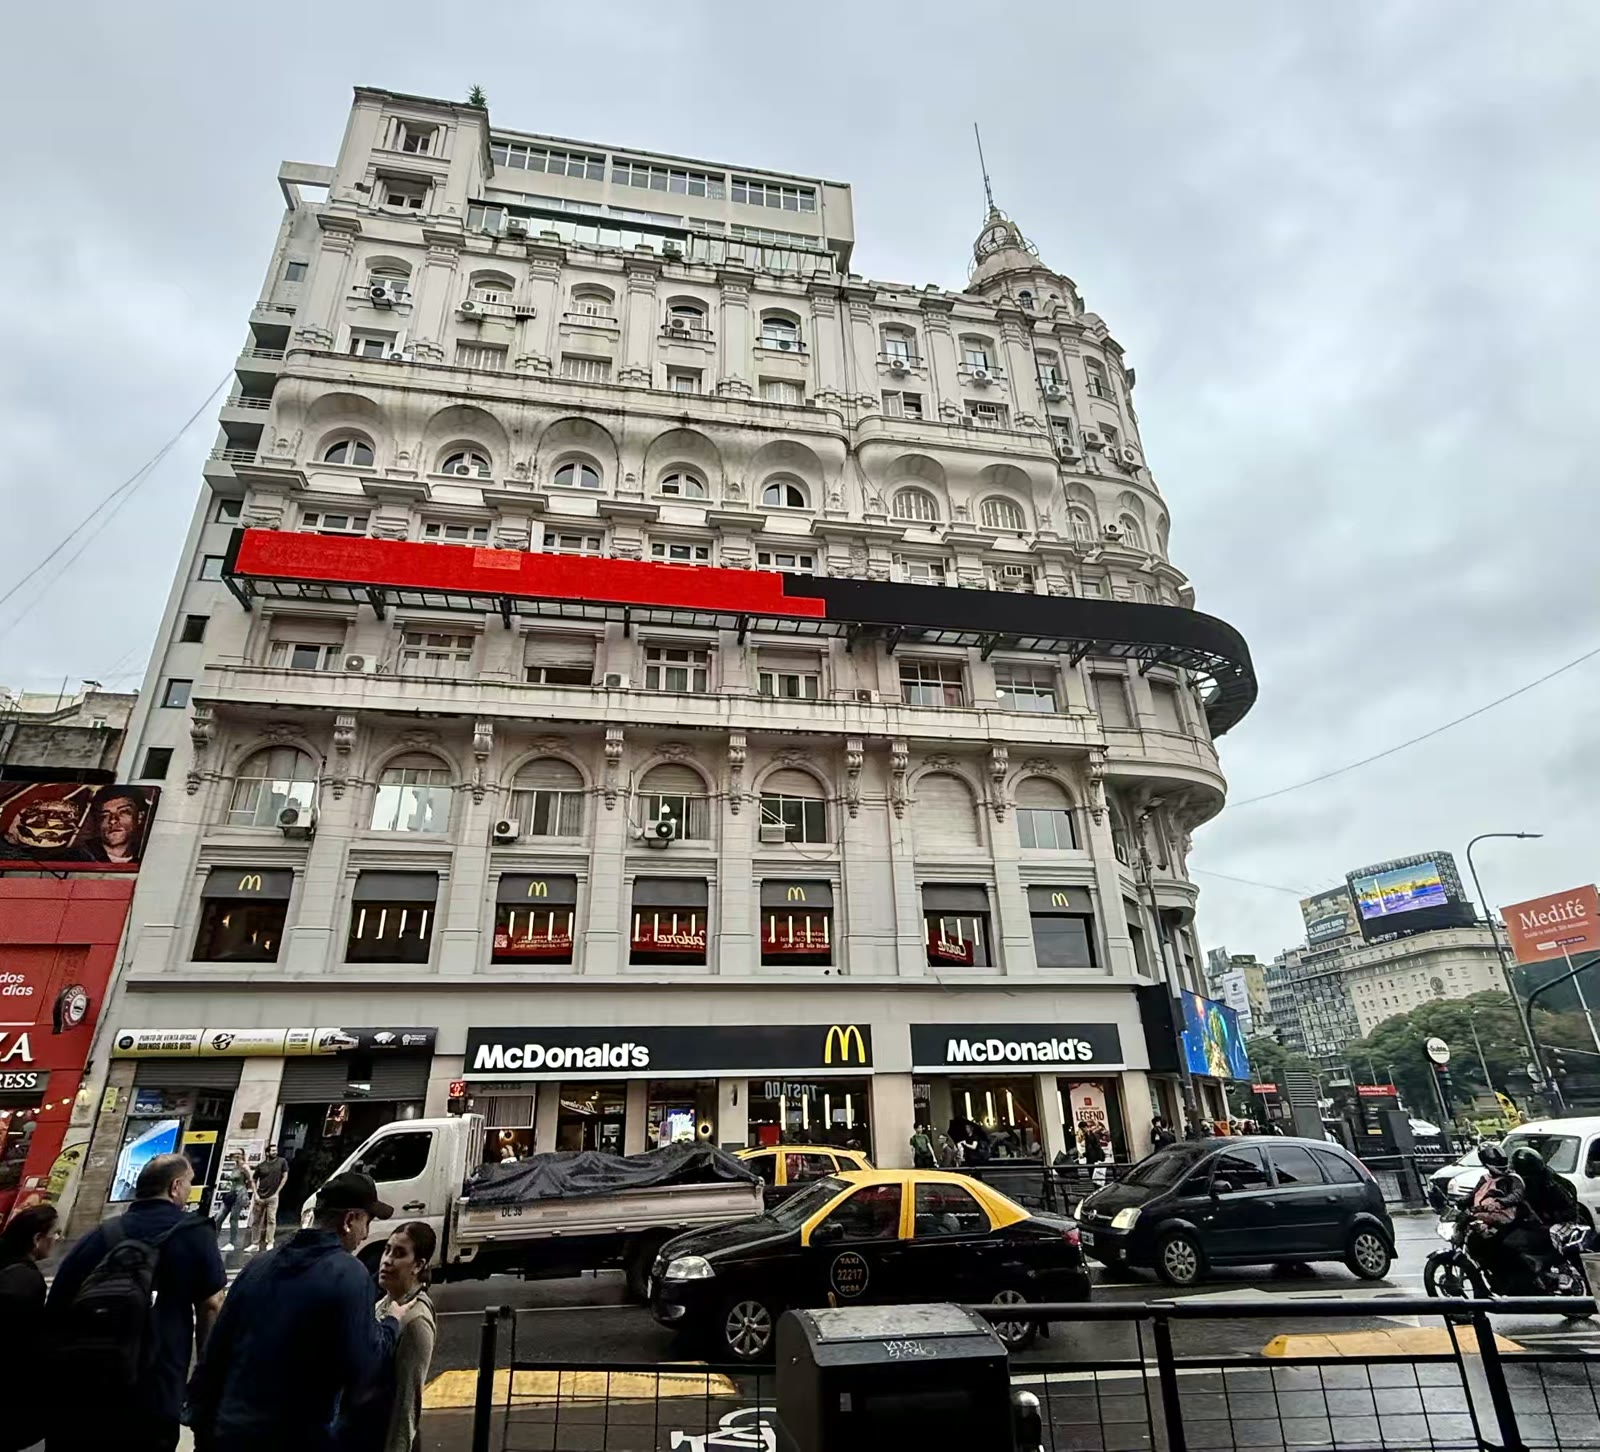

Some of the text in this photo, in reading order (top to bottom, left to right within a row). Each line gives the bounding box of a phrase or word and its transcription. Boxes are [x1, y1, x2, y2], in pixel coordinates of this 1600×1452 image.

[1518, 898, 1586, 930] Medifé
[2, 983, 34, 996] días
[137, 1042, 160, 1050] BUENOS
[161, 1042, 178, 1050] AIRES
[179, 1042, 191, 1050] BUS
[946, 1038, 1093, 1062] McDonald's
[473, 1042, 650, 1069] McDonald's
[1075, 1110, 1105, 1121] LEGEND
[837, 1269, 863, 1280] 22217
